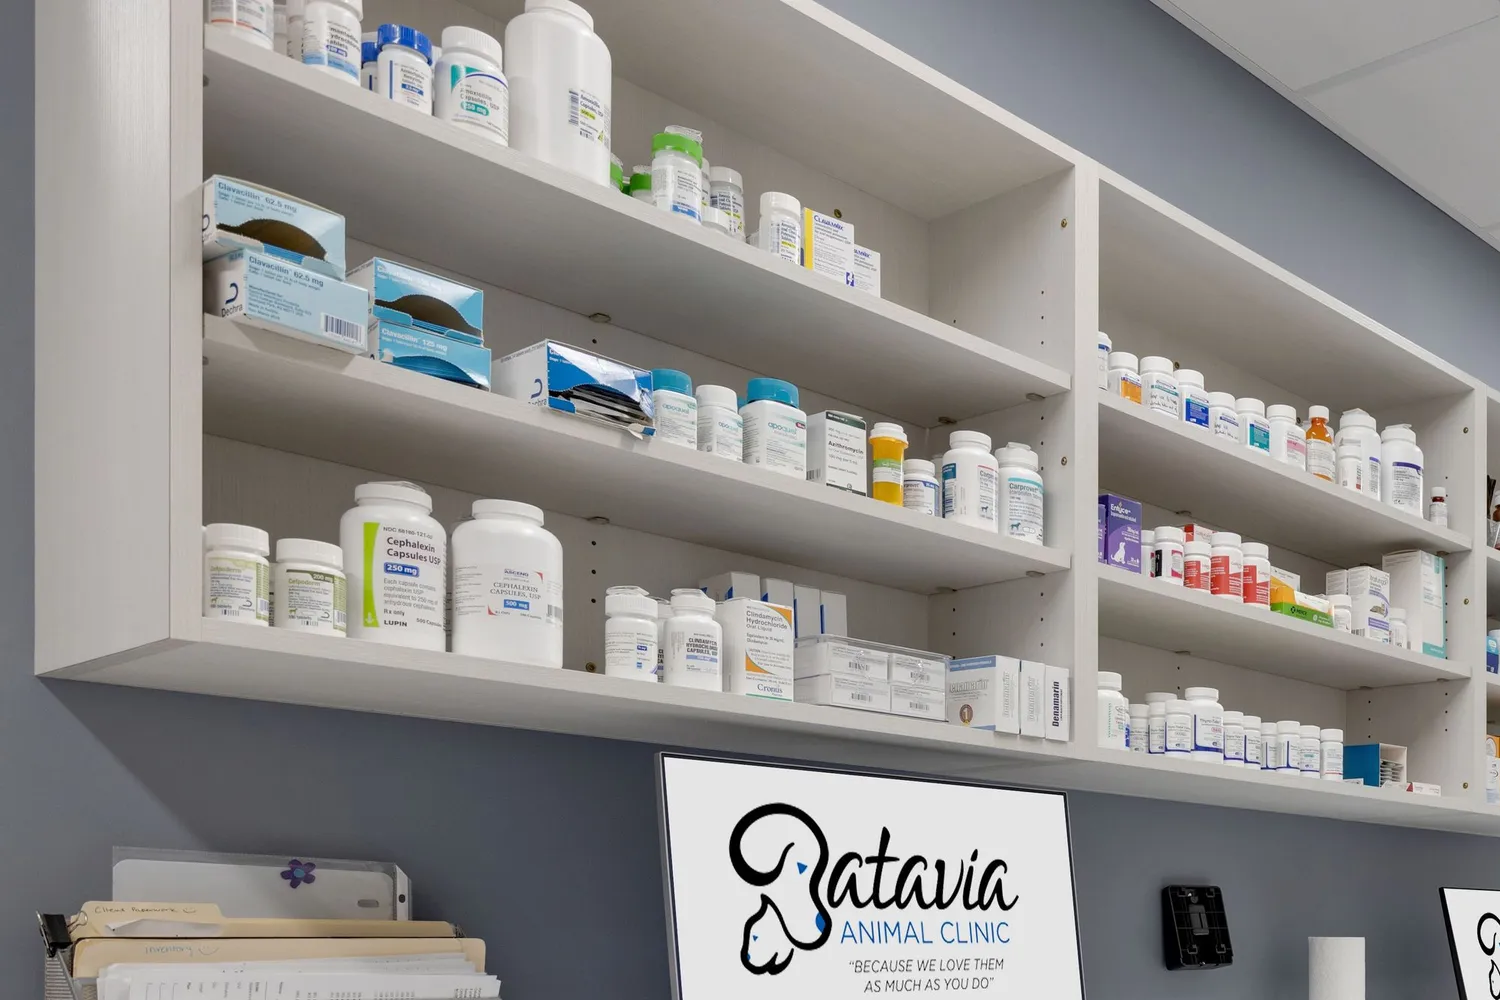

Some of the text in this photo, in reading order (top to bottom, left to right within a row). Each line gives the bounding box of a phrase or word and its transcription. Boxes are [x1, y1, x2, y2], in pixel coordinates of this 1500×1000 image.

[265, 197, 283, 208] 62.5
[284, 204, 298, 213] mg
[249, 255, 289, 274] Clavacillin
[293, 271, 310, 282] 62.5
[311, 277, 324, 287] mg
[221, 303, 243, 318] Dechra
[767, 421, 798, 435] apoquel
[828, 440, 864, 454] Azithromycin
[1009, 482, 1037, 493] Carprovet
[386, 536, 436, 553] Cephalexin
[386, 548, 441, 565] Capsules USP
[387, 564, 418, 575] 250 mg
[490, 588, 528, 598] CAPSULES,
[493, 582, 539, 593] CEPHALEXIN
[518, 602, 528, 610] mg
[746, 610, 783, 622] Clindamycin
[746, 617, 788, 629] Hydrochloride
[757, 684, 783, 694] Cronus
[949, 679, 989, 694] enamarin
[1051, 681, 1060, 727] Denamarin
[840, 921, 1010, 944] ANIMAL CLINIC
[849, 958, 1004, 973] “BECAUSE WE LOVE THEM
[864, 977, 995, 993] AS MUCH AS YOU DO”
